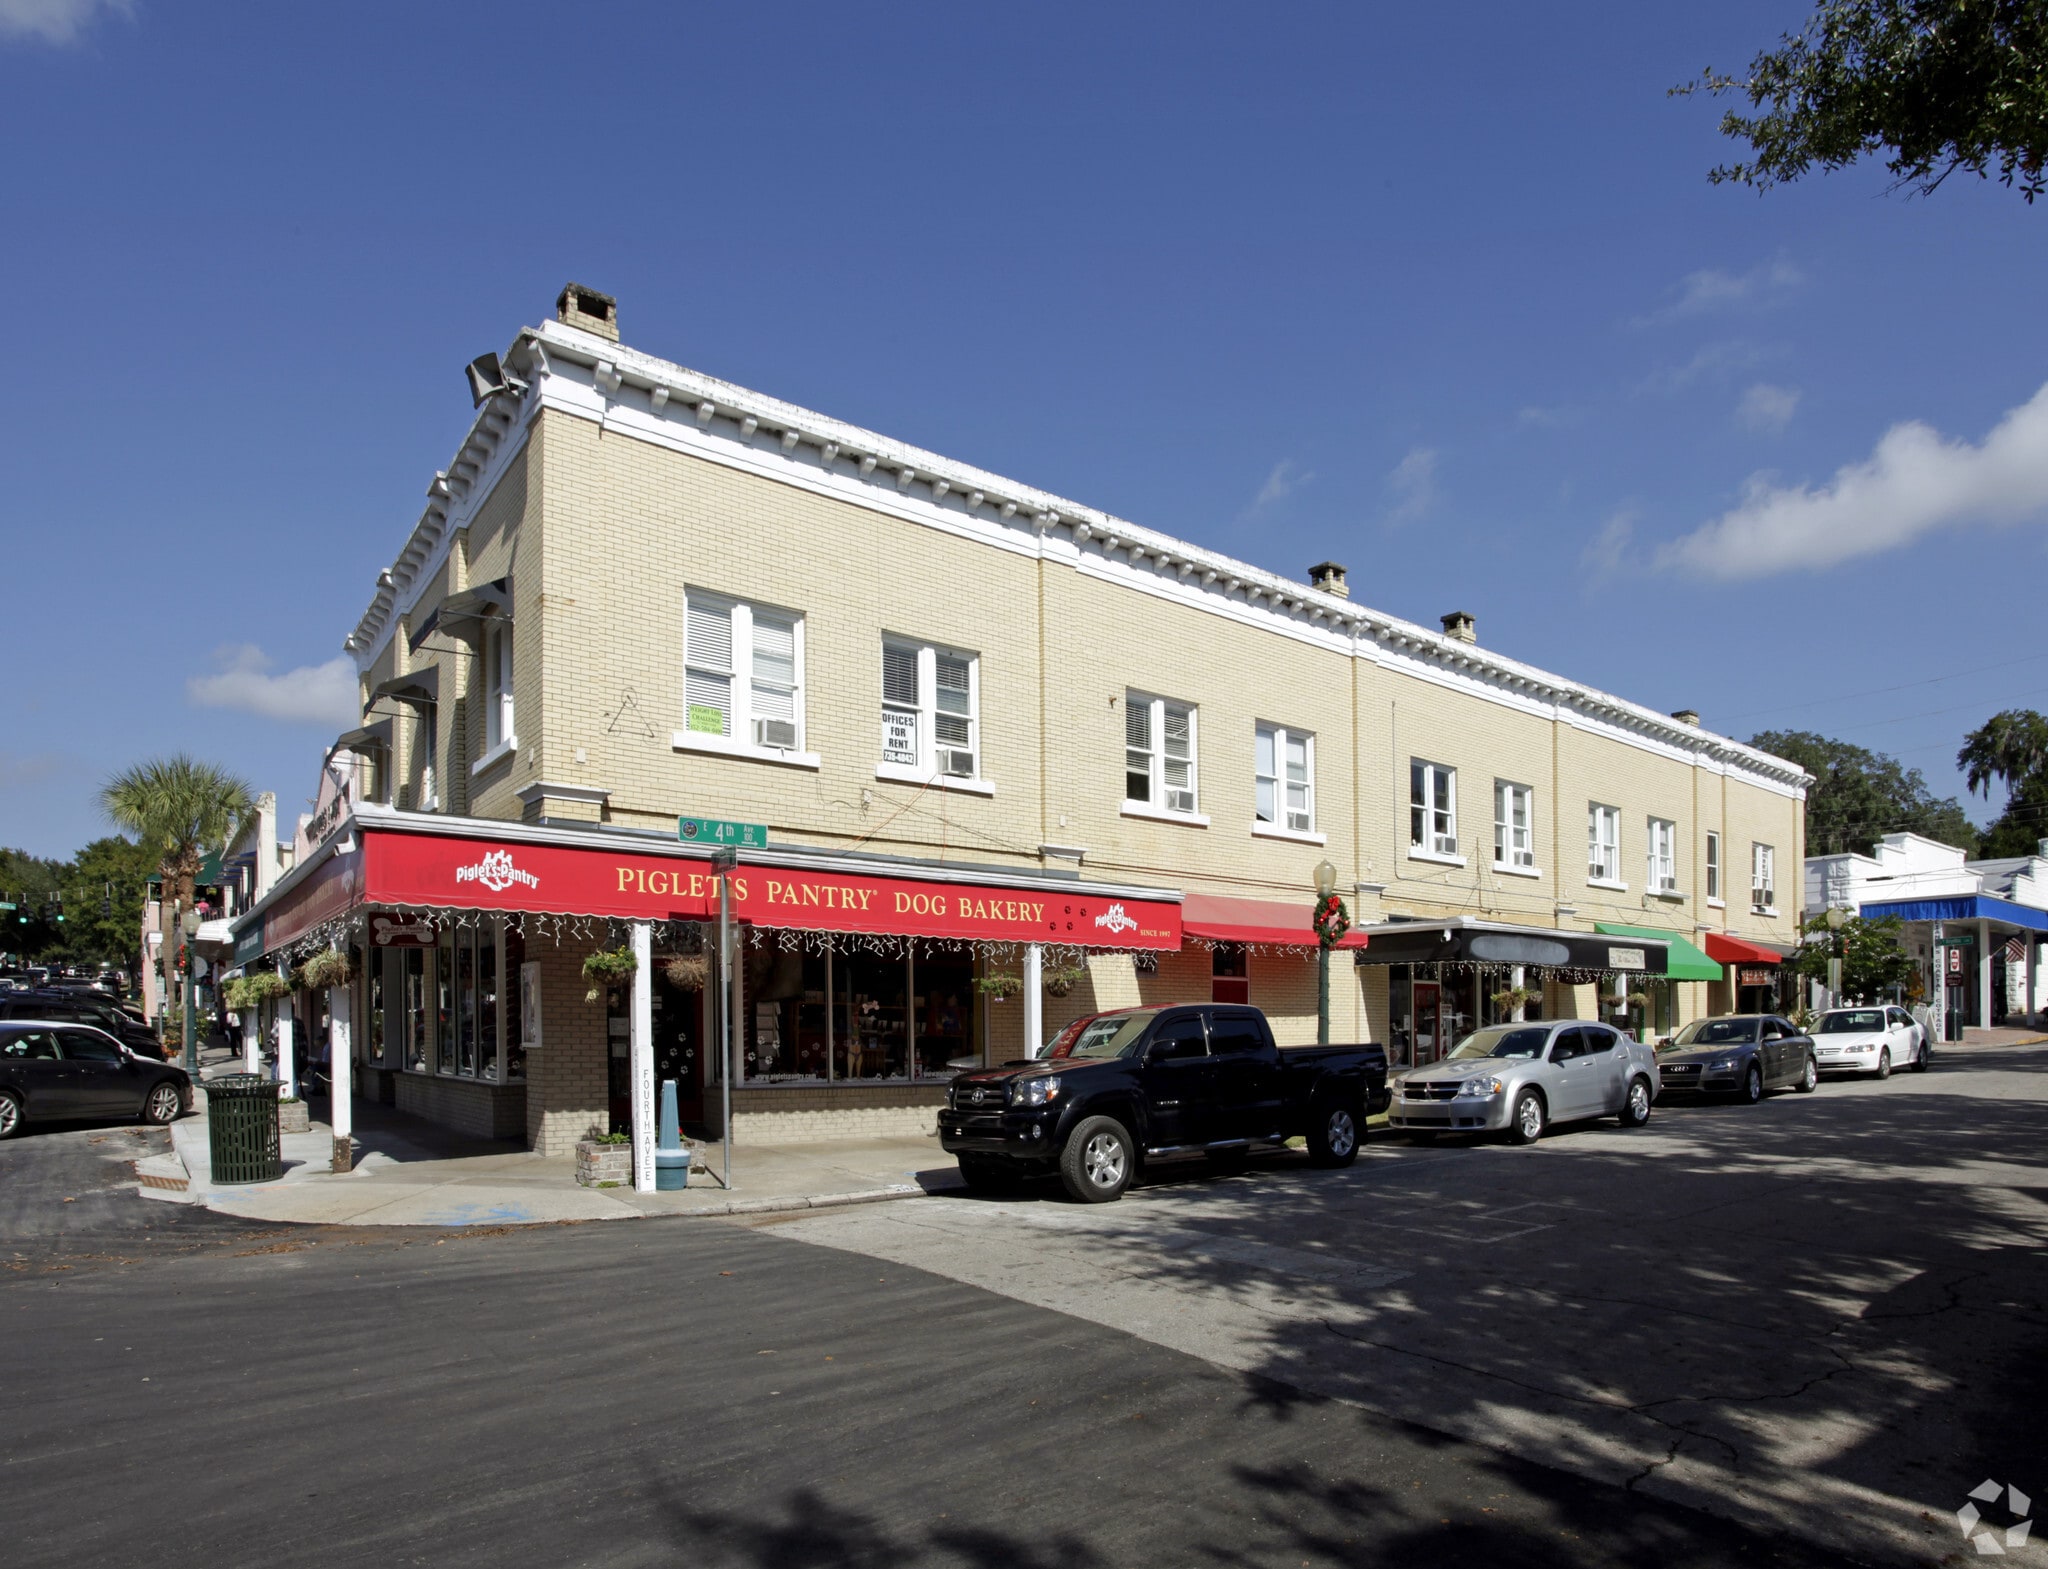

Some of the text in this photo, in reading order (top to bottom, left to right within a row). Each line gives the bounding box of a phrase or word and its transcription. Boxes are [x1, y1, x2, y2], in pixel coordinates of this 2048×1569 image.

[882, 713, 914, 727] OFFICES
[890, 726, 906, 738] FOR
[888, 737, 908, 750] RENT
[703, 821, 735, 842] E 4th
[456, 863, 539, 890] Piglet's Pantry
[616, 867, 748, 901] PIGLET'S
[893, 892, 947, 916] DOG
[958, 898, 1045, 923] BAKERY
[1140, 929, 1158, 937] SINCE
[645, 1171, 651, 1181] E
